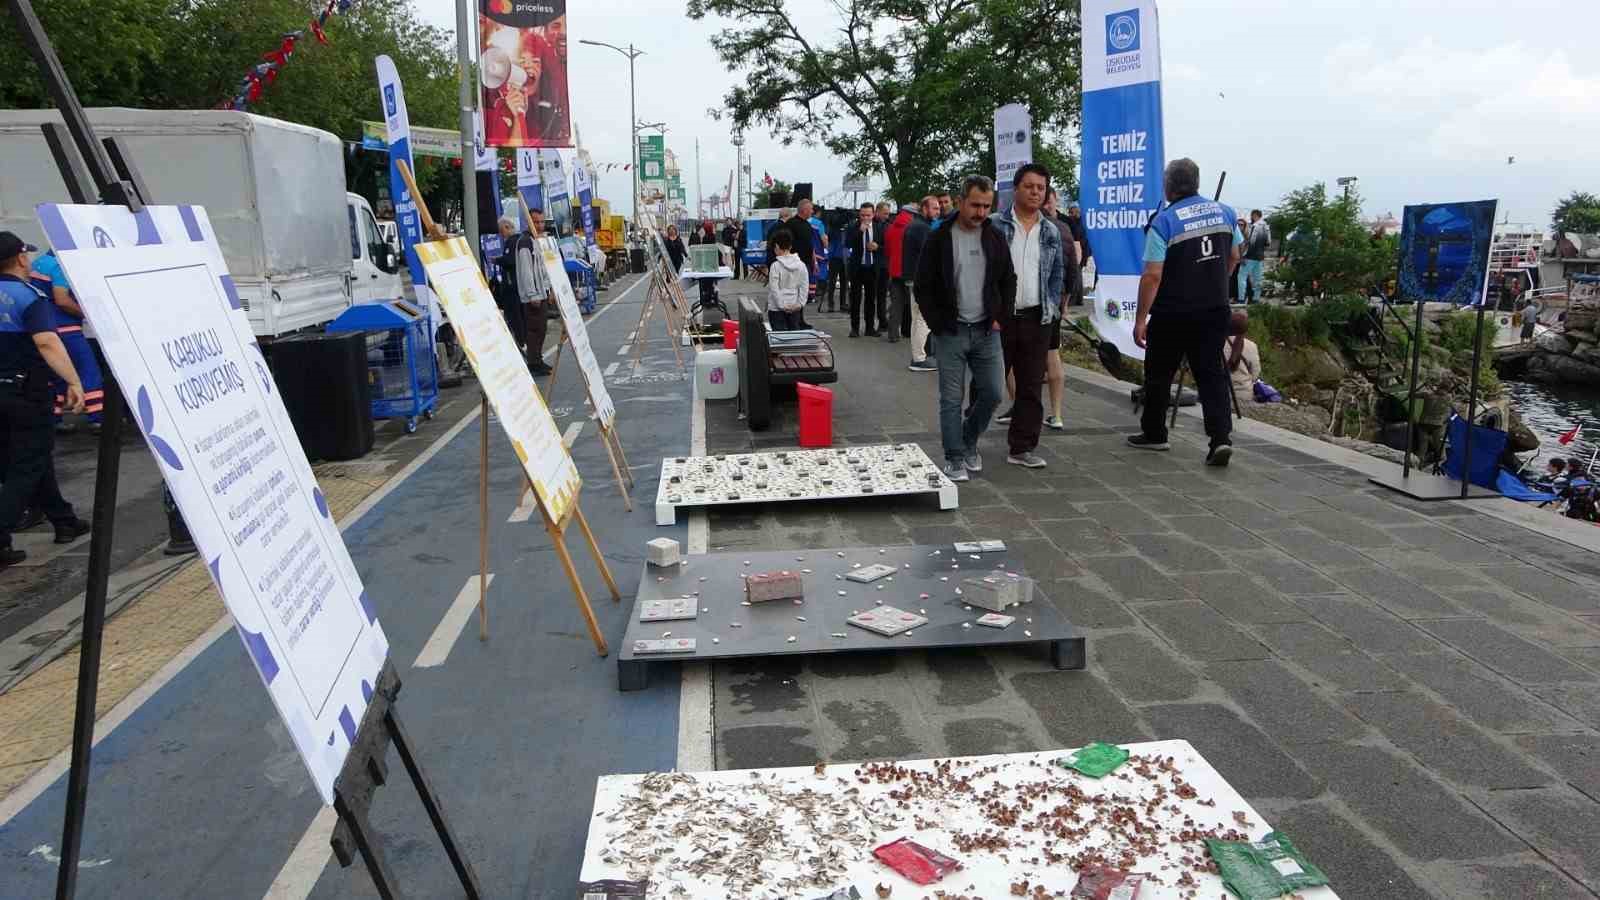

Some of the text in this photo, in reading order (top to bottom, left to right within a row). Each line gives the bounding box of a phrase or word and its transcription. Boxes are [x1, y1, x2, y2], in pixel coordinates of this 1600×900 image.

[516, 4, 554, 13] priceless
[1101, 129, 1147, 154] TEMİZ
[1097, 158, 1145, 184] ÇEVRE
[1097, 181, 1144, 205] TEMİZ
[161, 327, 224, 373] KABUKLU
[174, 359, 246, 414] KURUYEMİŞ
